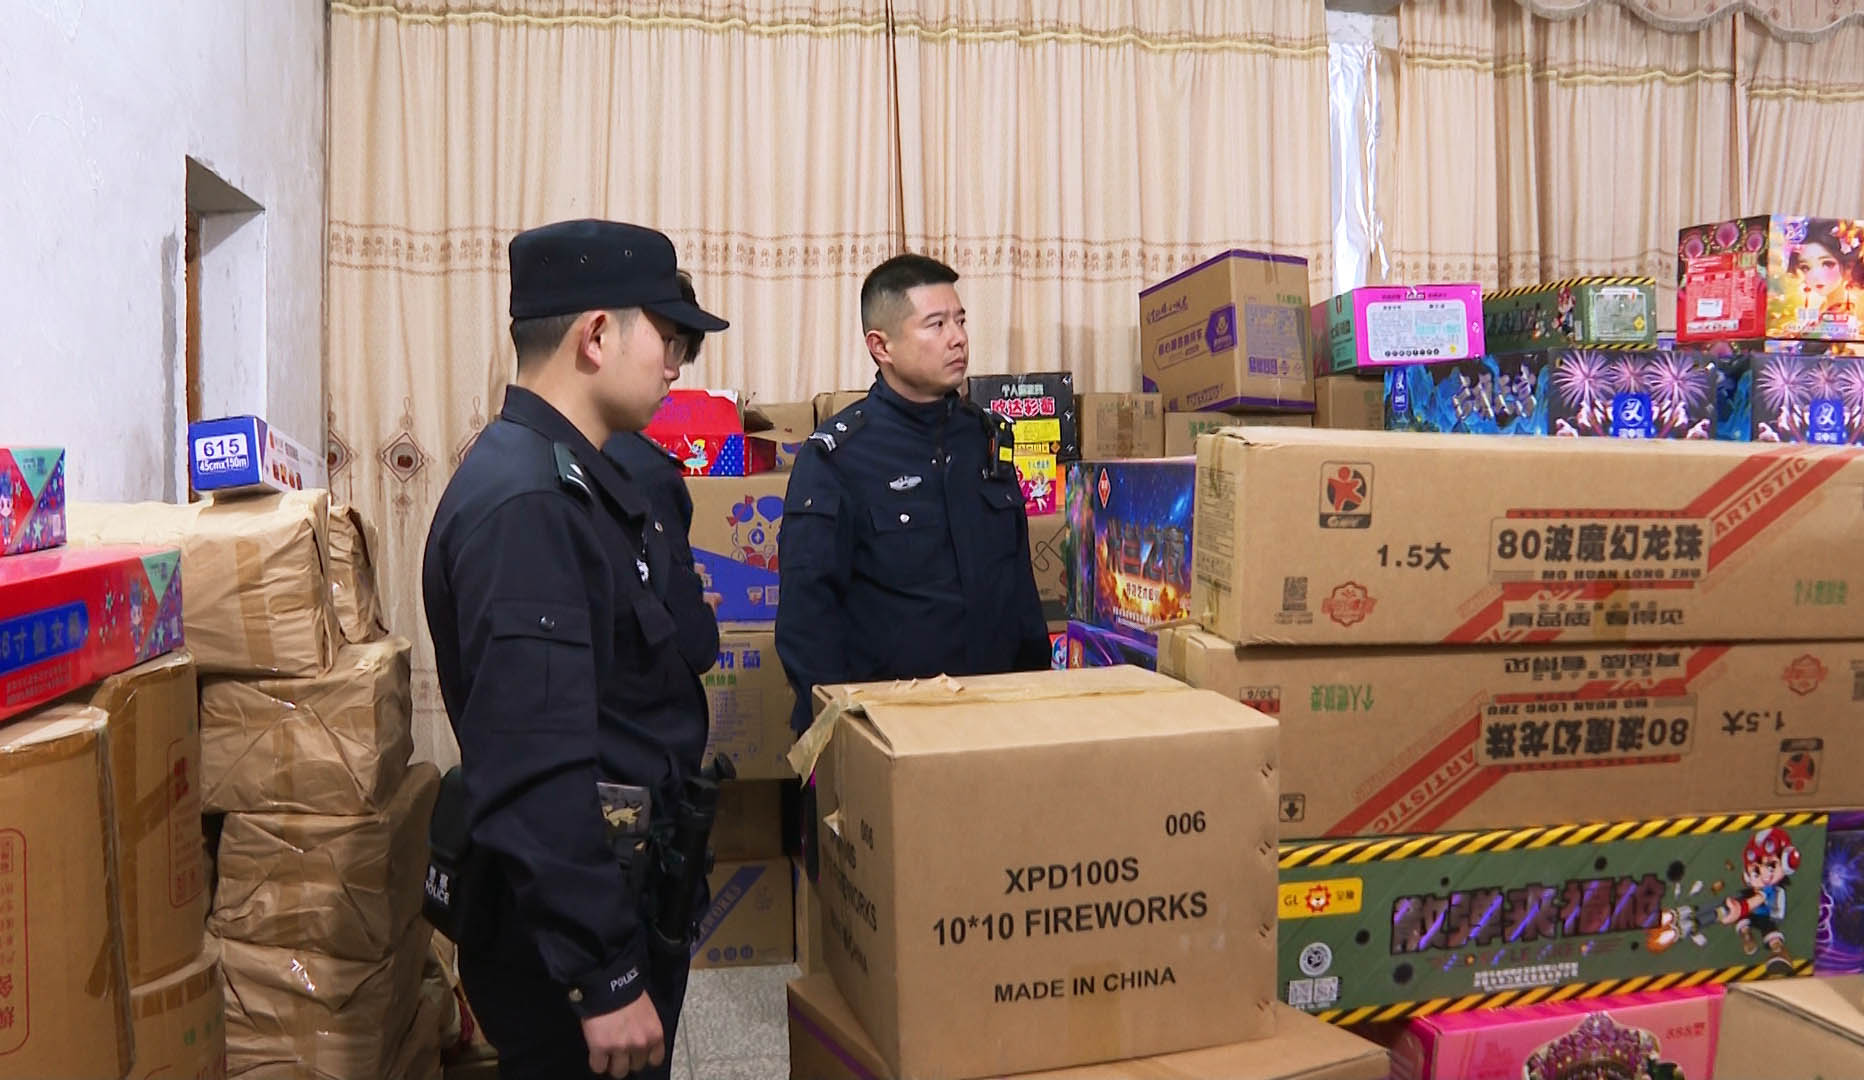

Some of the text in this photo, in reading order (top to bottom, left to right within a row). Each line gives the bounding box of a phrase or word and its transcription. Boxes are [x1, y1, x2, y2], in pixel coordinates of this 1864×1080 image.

[203, 438, 240, 457] 615
[1714, 456, 1809, 537] ARTISTIC
[1376, 542, 1452, 571] 1.5大
[1496, 523, 1704, 562] 80波魔幻龙珠
[1541, 568, 1701, 580] MO HUAN LONG ZHU
[1525, 702, 1568, 714] LONG
[1573, 700, 1618, 711] HUAN
[1721, 710, 1785, 736] 1.5大
[1373, 747, 1474, 834] ARTISTIC
[1165, 810, 1207, 836] 006
[1004, 856, 1140, 894] XPD100S
[1025, 891, 1209, 937] FIREWORKS
[994, 966, 1177, 1003] MADE IN CHINA
